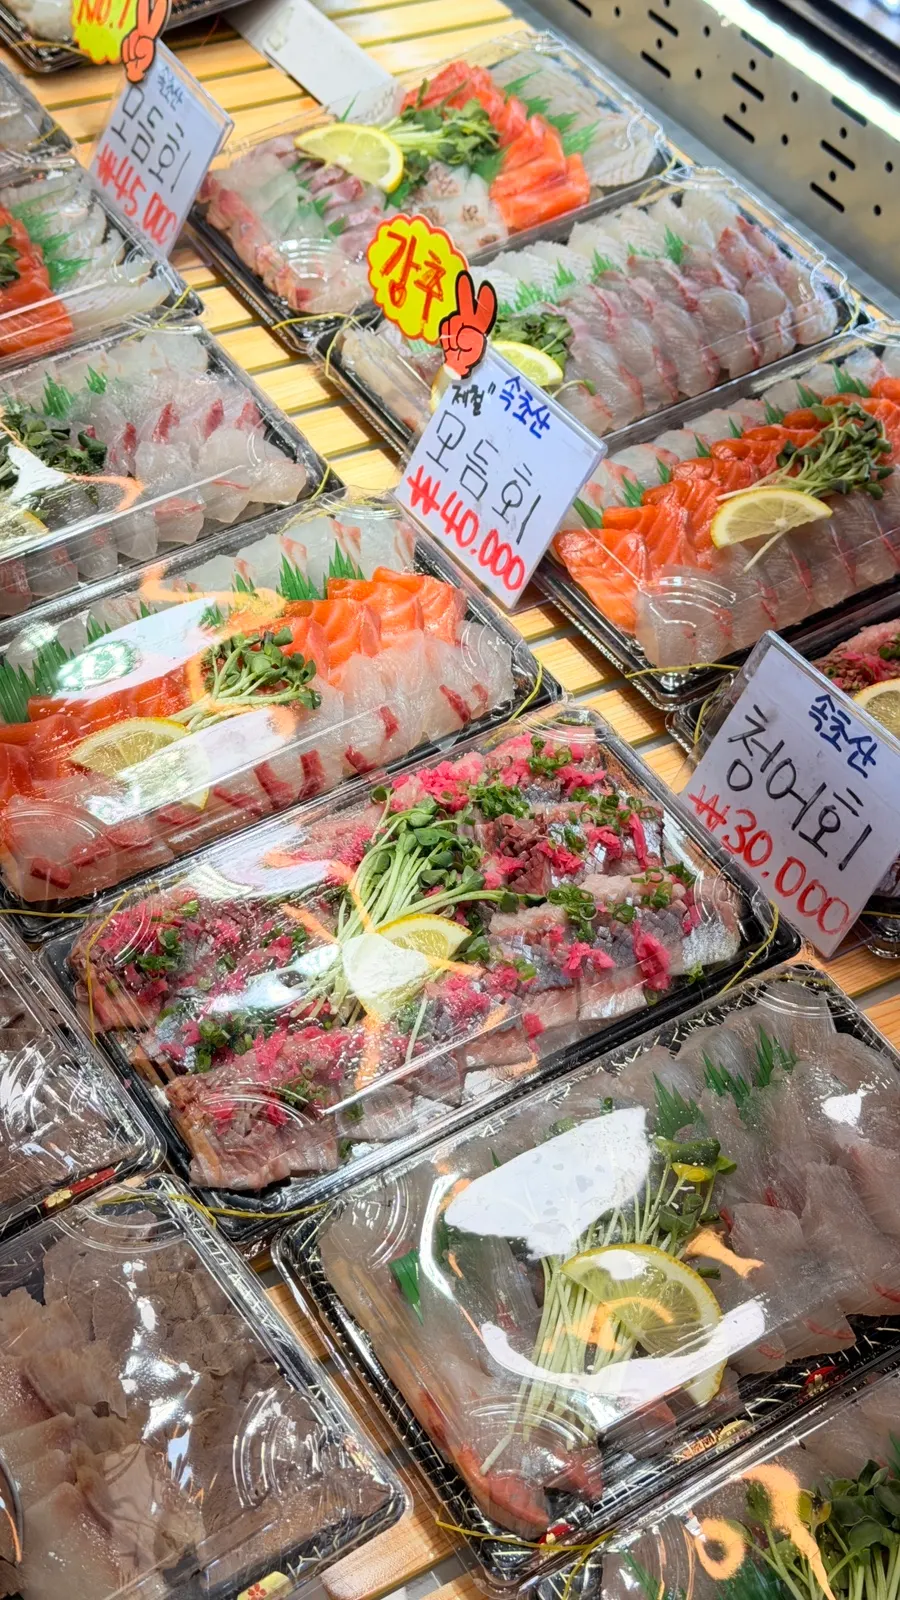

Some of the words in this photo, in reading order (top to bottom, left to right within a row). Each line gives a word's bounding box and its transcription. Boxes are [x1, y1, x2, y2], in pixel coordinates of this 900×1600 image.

[111, 86, 191, 193] 모듬회
[378, 231, 446, 323] 강추
[499, 376, 550, 439] 속초산
[407, 466, 525, 591] ₩40.000
[426, 410, 541, 544] 모듬회
[727, 705, 872, 870] 청어회
[809, 694, 877, 778] 속초산
[688, 785, 850, 935] ₩30.000
